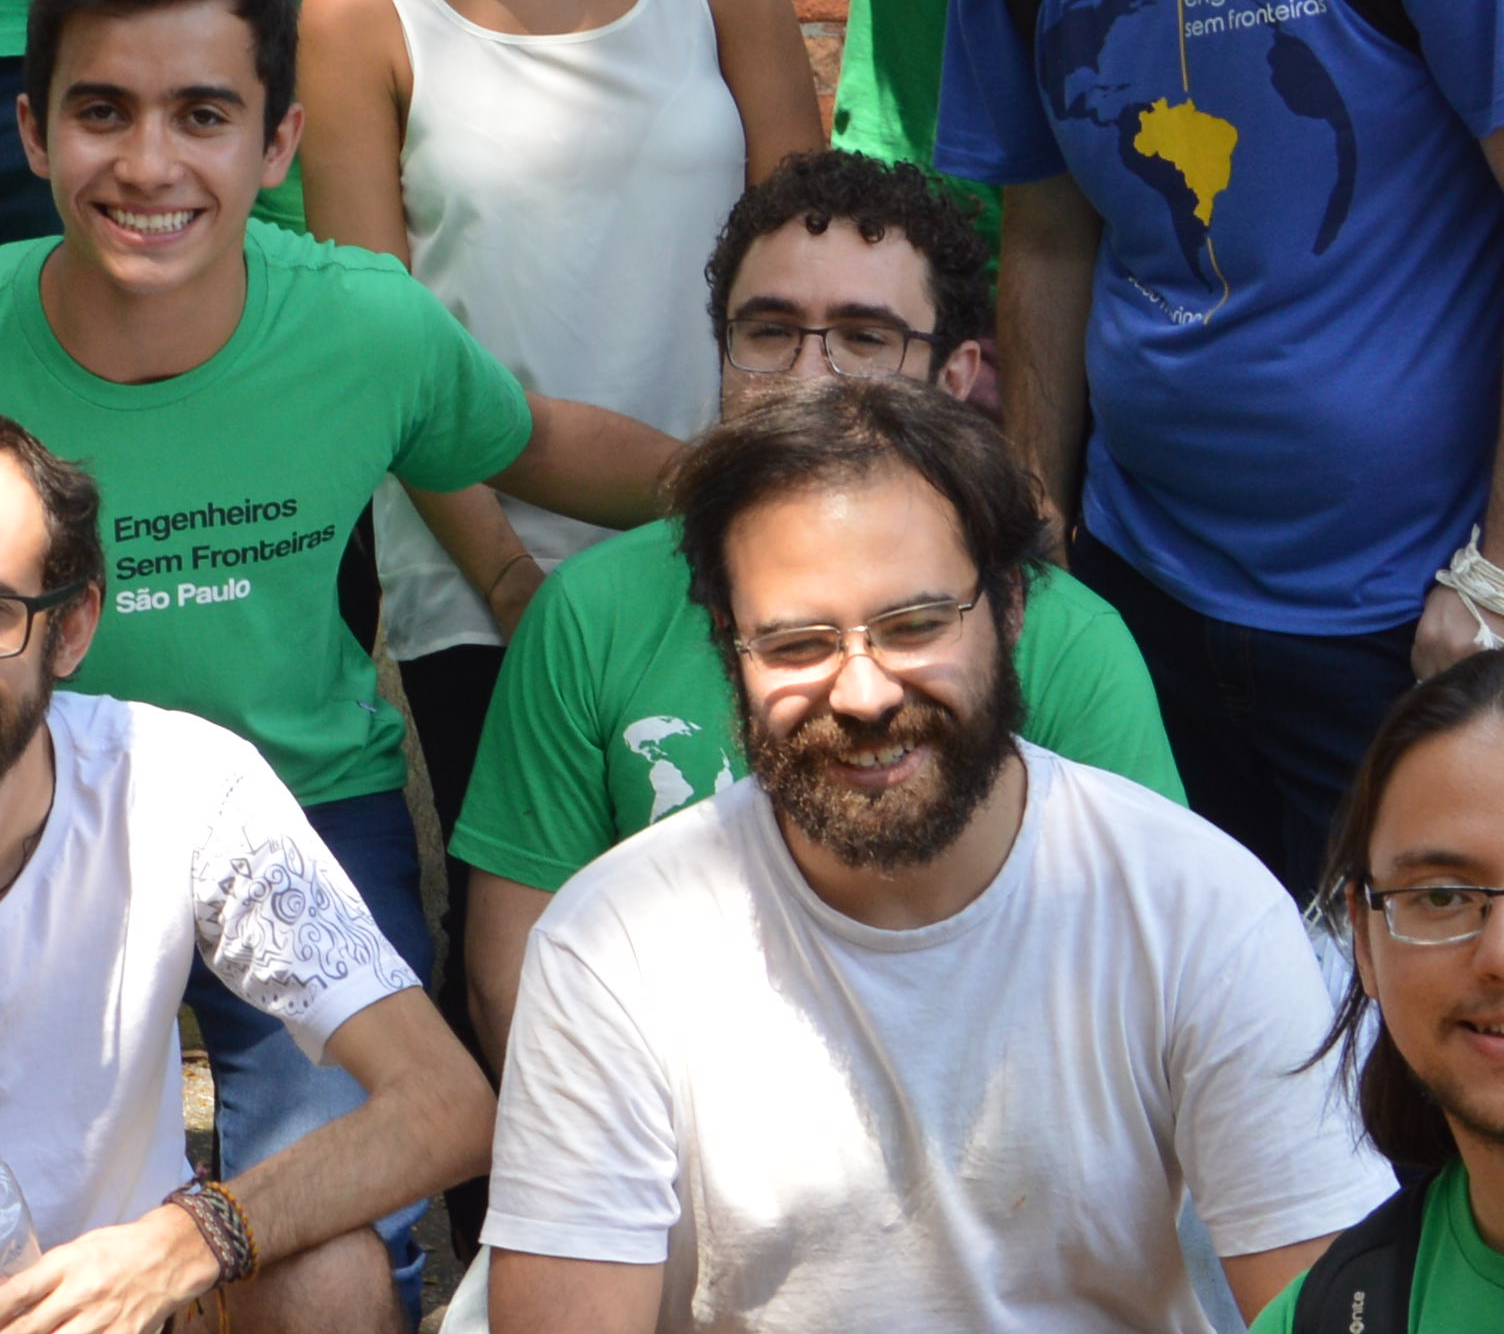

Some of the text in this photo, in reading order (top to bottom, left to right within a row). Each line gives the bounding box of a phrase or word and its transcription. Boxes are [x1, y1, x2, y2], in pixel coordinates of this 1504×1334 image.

[1185, 14, 1225, 38] sem
[114, 497, 298, 543] Engenheiros
[116, 523, 336, 580] Sem Fronteiras
[115, 577, 252, 614] São Paulo
